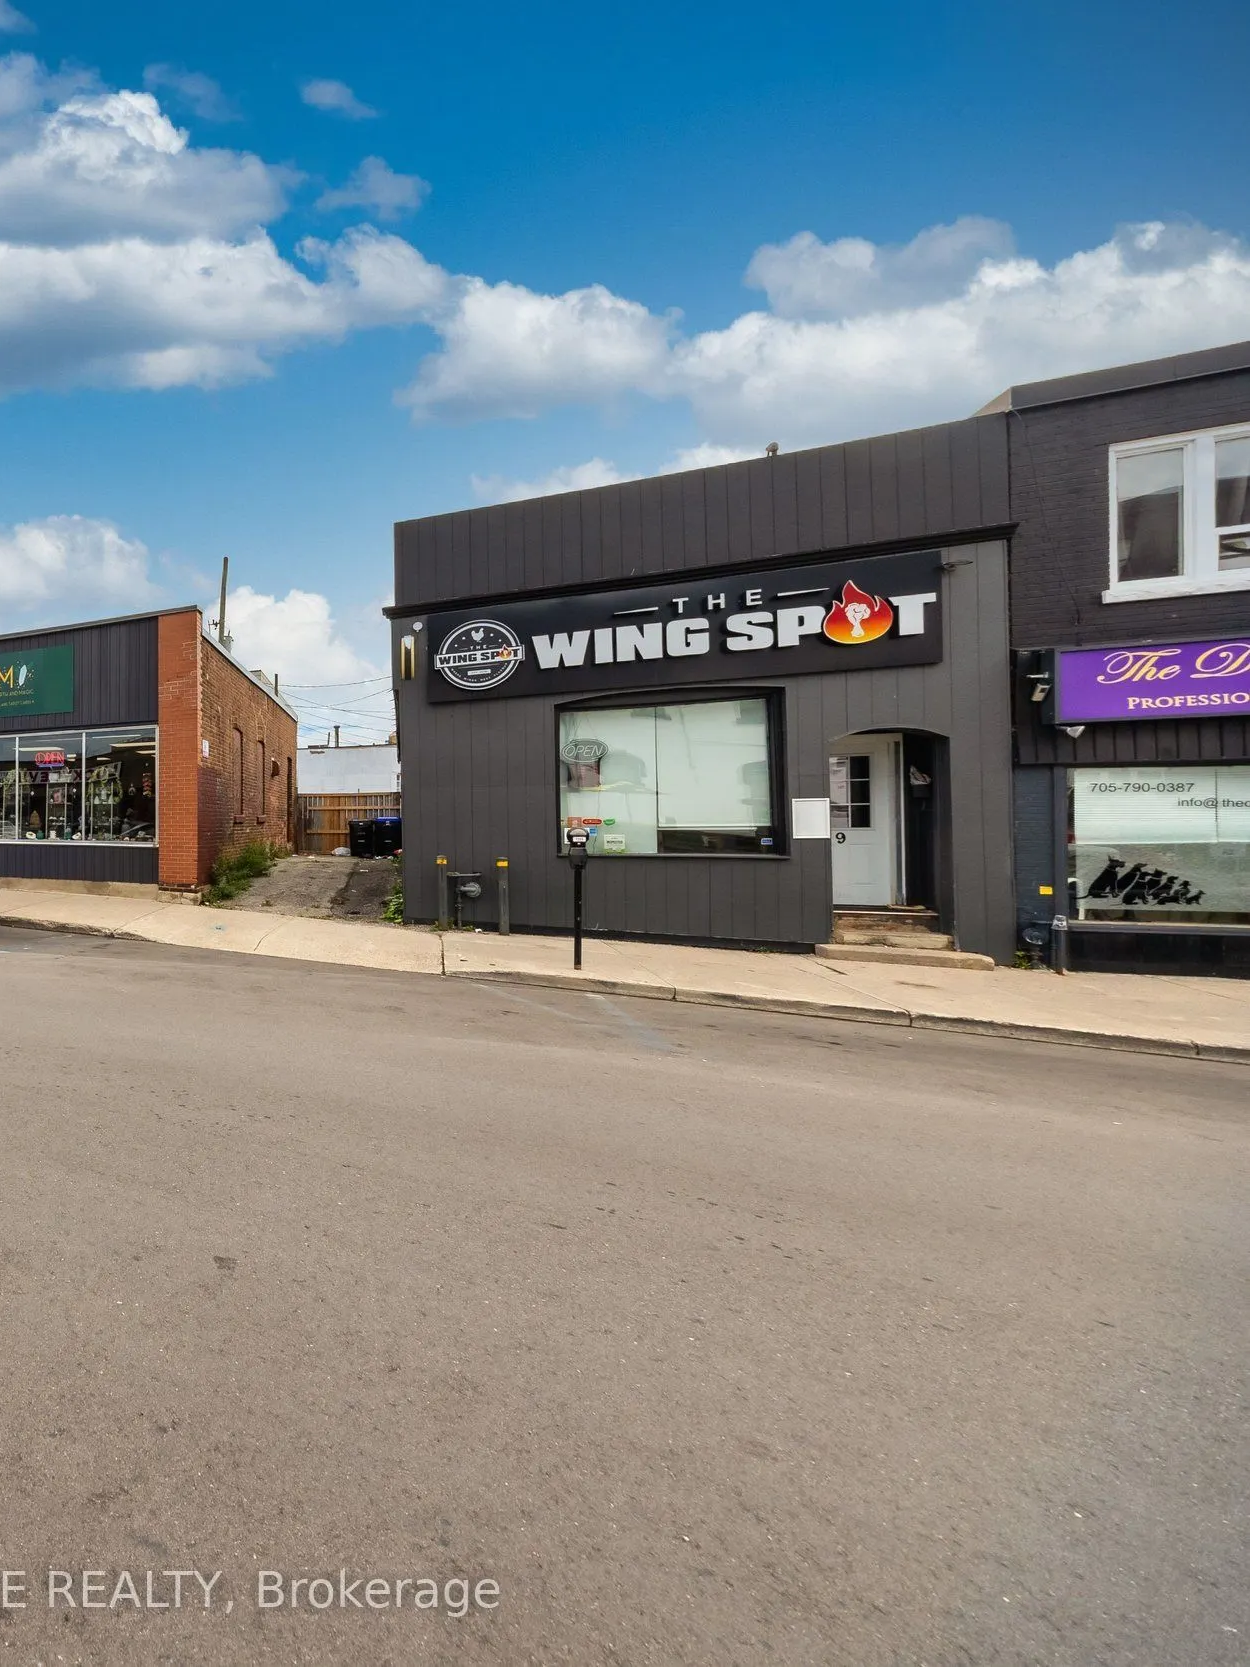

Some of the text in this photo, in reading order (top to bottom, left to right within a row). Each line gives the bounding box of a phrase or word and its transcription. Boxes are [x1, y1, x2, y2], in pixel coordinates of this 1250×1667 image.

[672, 589, 763, 614] THE
[531, 617, 710, 669] WING
[438, 653, 478, 666] WING
[1097, 648, 1182, 684] The
[1127, 692, 1250, 710] PROFESSIO
[35, 751, 65, 766] OPEN
[565, 745, 604, 757] OPEN
[1090, 782, 1195, 793] 705-790-0387
[835, 832, 847, 844] 9
